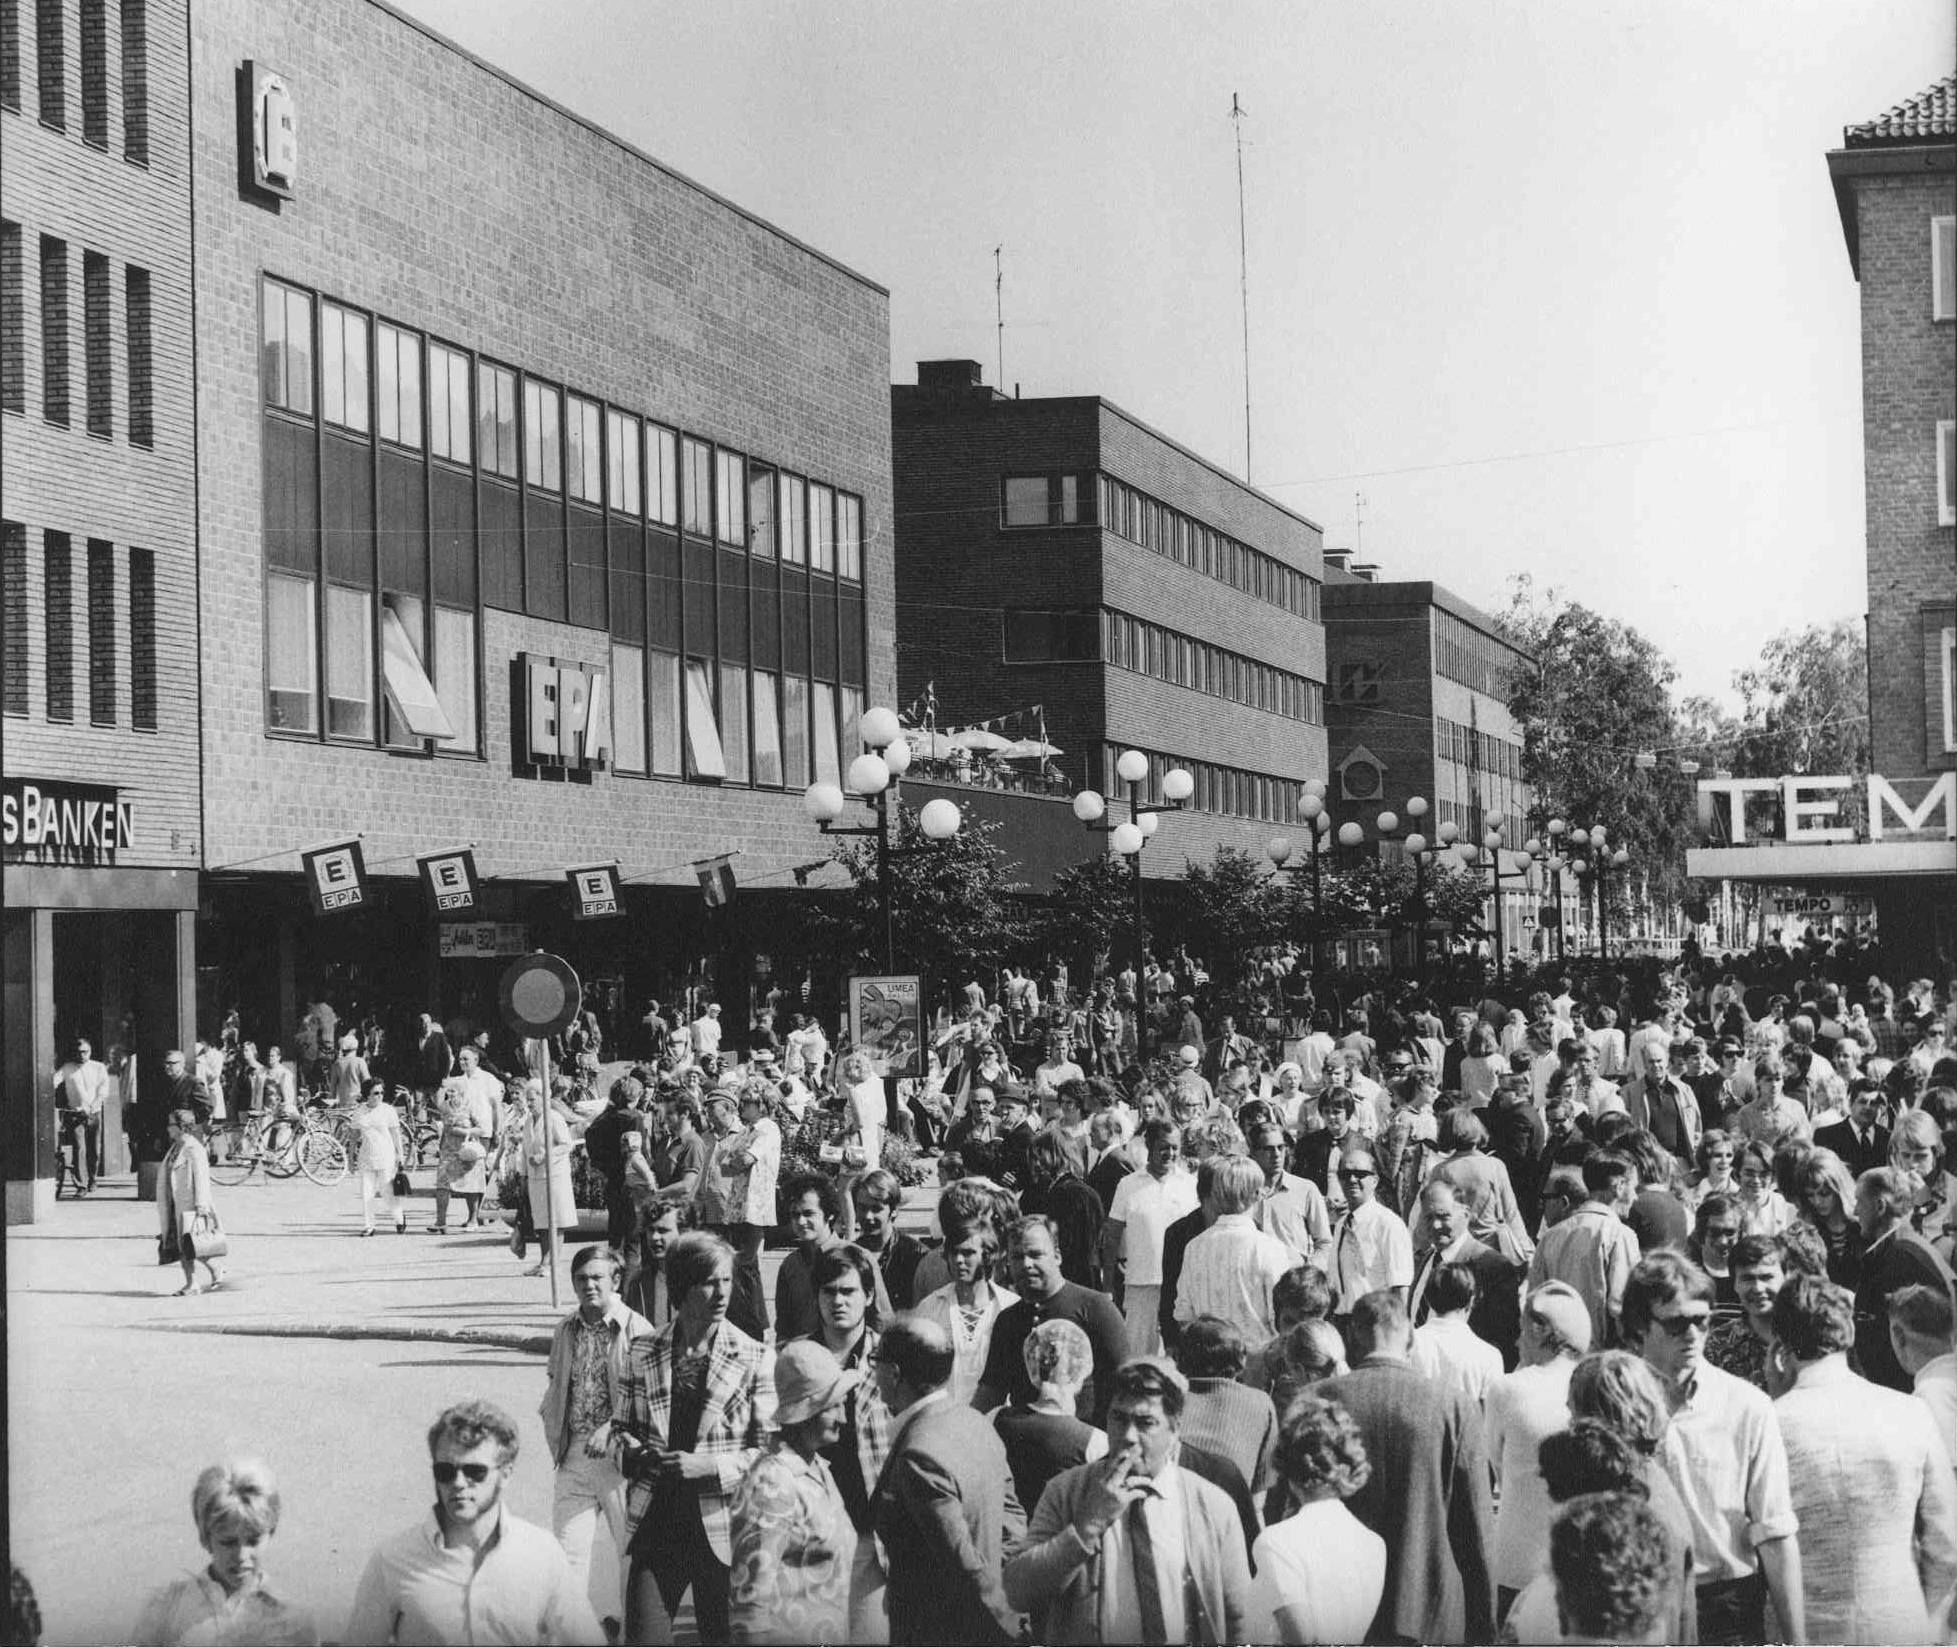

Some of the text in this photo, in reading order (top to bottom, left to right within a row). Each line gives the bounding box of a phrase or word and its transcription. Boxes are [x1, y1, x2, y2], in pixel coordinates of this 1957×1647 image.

[1697, 772, 1956, 843] TEM
[326, 860, 346, 883] E
[440, 867, 458, 887] E
[586, 878, 604, 894] E
[323, 891, 360, 908] EPA
[439, 895, 472, 909] EPA
[1773, 898, 1831, 912] TEMPO
[584, 902, 615, 914] EPA
